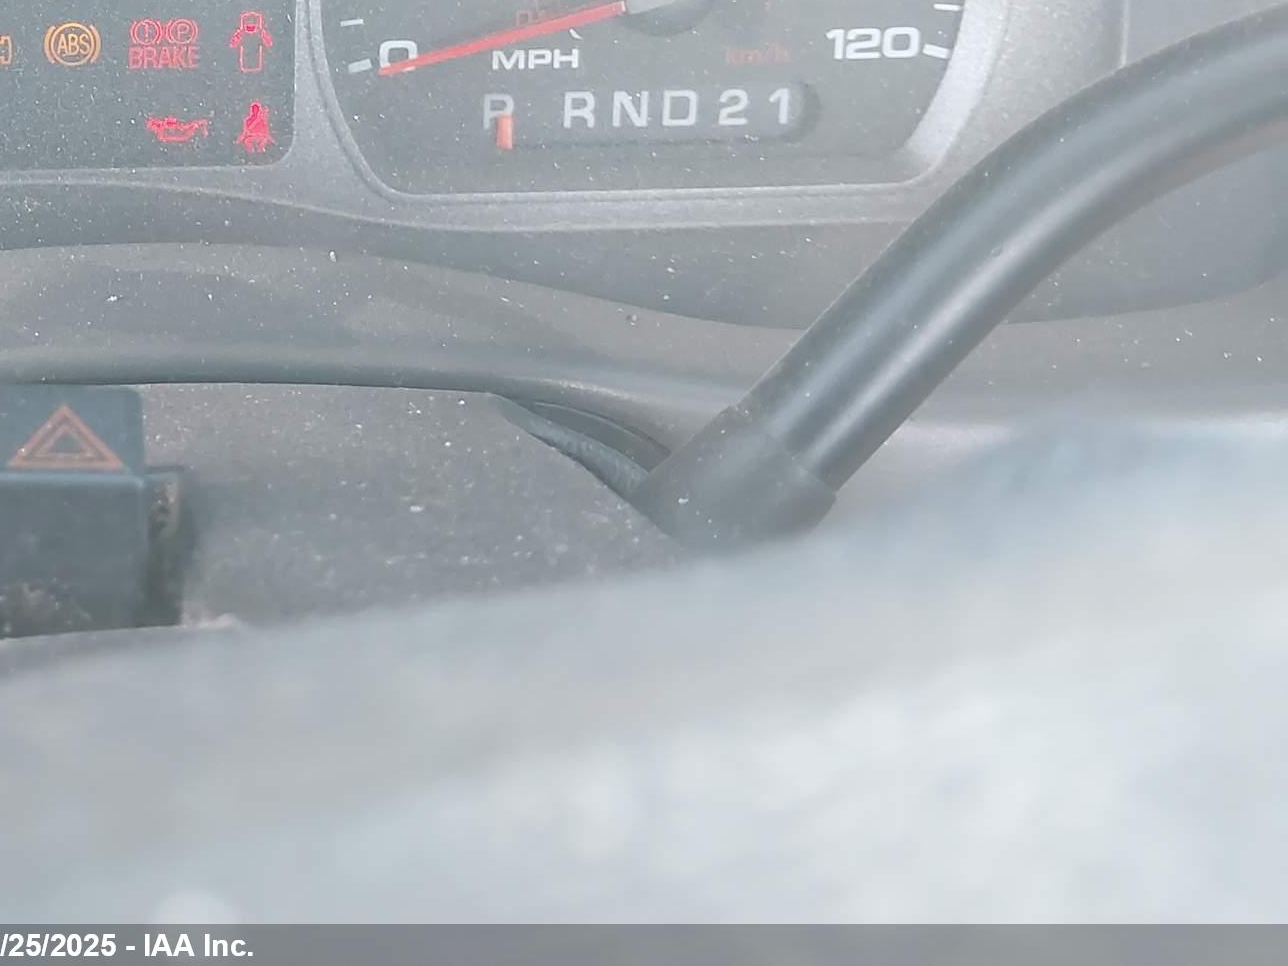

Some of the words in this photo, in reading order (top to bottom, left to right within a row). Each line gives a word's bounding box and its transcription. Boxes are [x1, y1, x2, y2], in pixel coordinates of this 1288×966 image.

[57, 33, 89, 55] ABS
[825, 26, 920, 60] 120
[129, 46, 200, 70] BRAKE
[379, 40, 418, 72] 0
[492, 48, 581, 70] MPH
